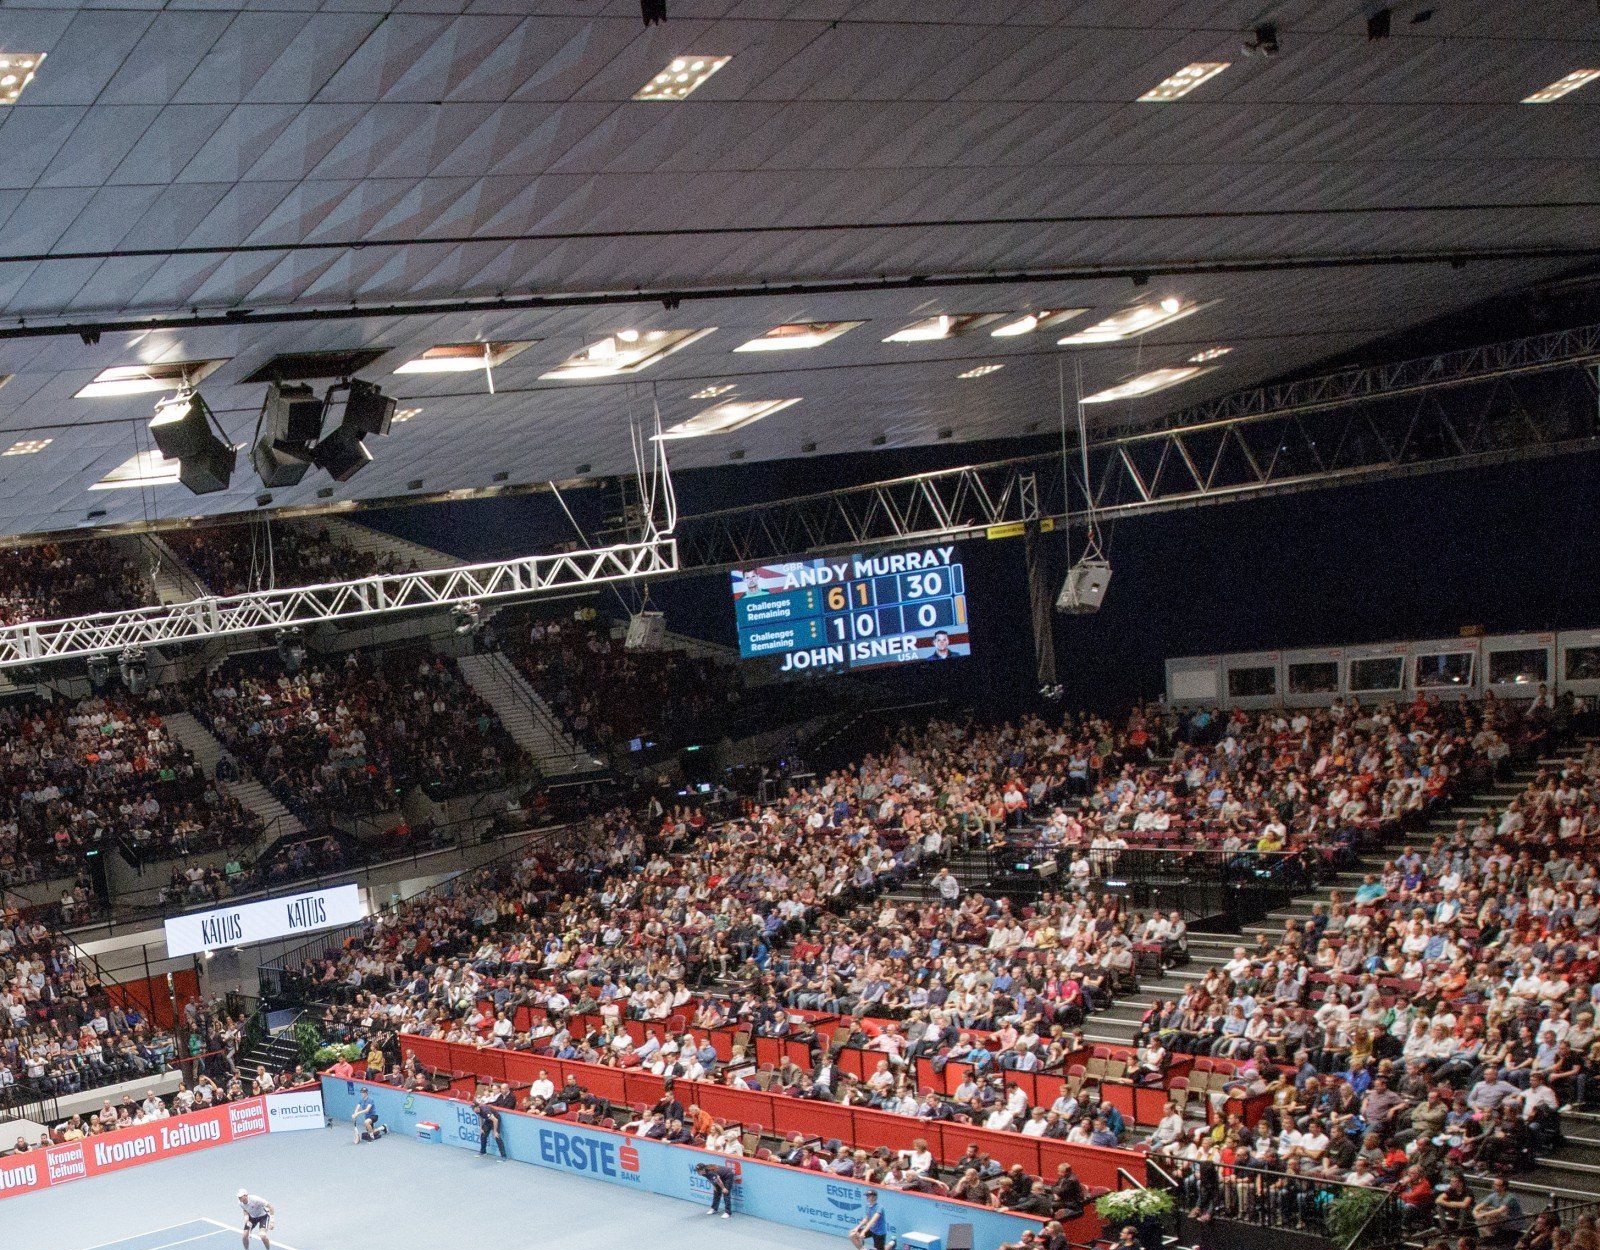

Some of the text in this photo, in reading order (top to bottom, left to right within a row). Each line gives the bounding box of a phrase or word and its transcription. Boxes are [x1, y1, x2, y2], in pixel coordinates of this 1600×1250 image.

[783, 562, 804, 572] GBR
[783, 546, 954, 589] ANDY MURRAY
[828, 572, 942, 610] 6 1 30
[746, 598, 790, 612] Challenges
[748, 608, 790, 621] Remaining
[834, 604, 937, 640] 1 0 0
[750, 628, 794, 642] Challenges
[751, 638, 794, 652] Remaining
[781, 634, 918, 672] JOHN ISNER
[898, 652, 918, 662] USA
[286, 897, 327, 928] KATTUS
[230, 1104, 263, 1122] Kronen
[232, 1116, 264, 1134] Zeitung
[94, 1119, 221, 1167] Kronen Zeitung
[48, 1148, 83, 1166] Kronen
[539, 1128, 617, 1177] ERSTE
[50, 1162, 85, 1180] Zeitung
[621, 1171, 641, 1182] BANK
[826, 1184, 854, 1200] ERSTE
[797, 1205, 834, 1219] wiener
